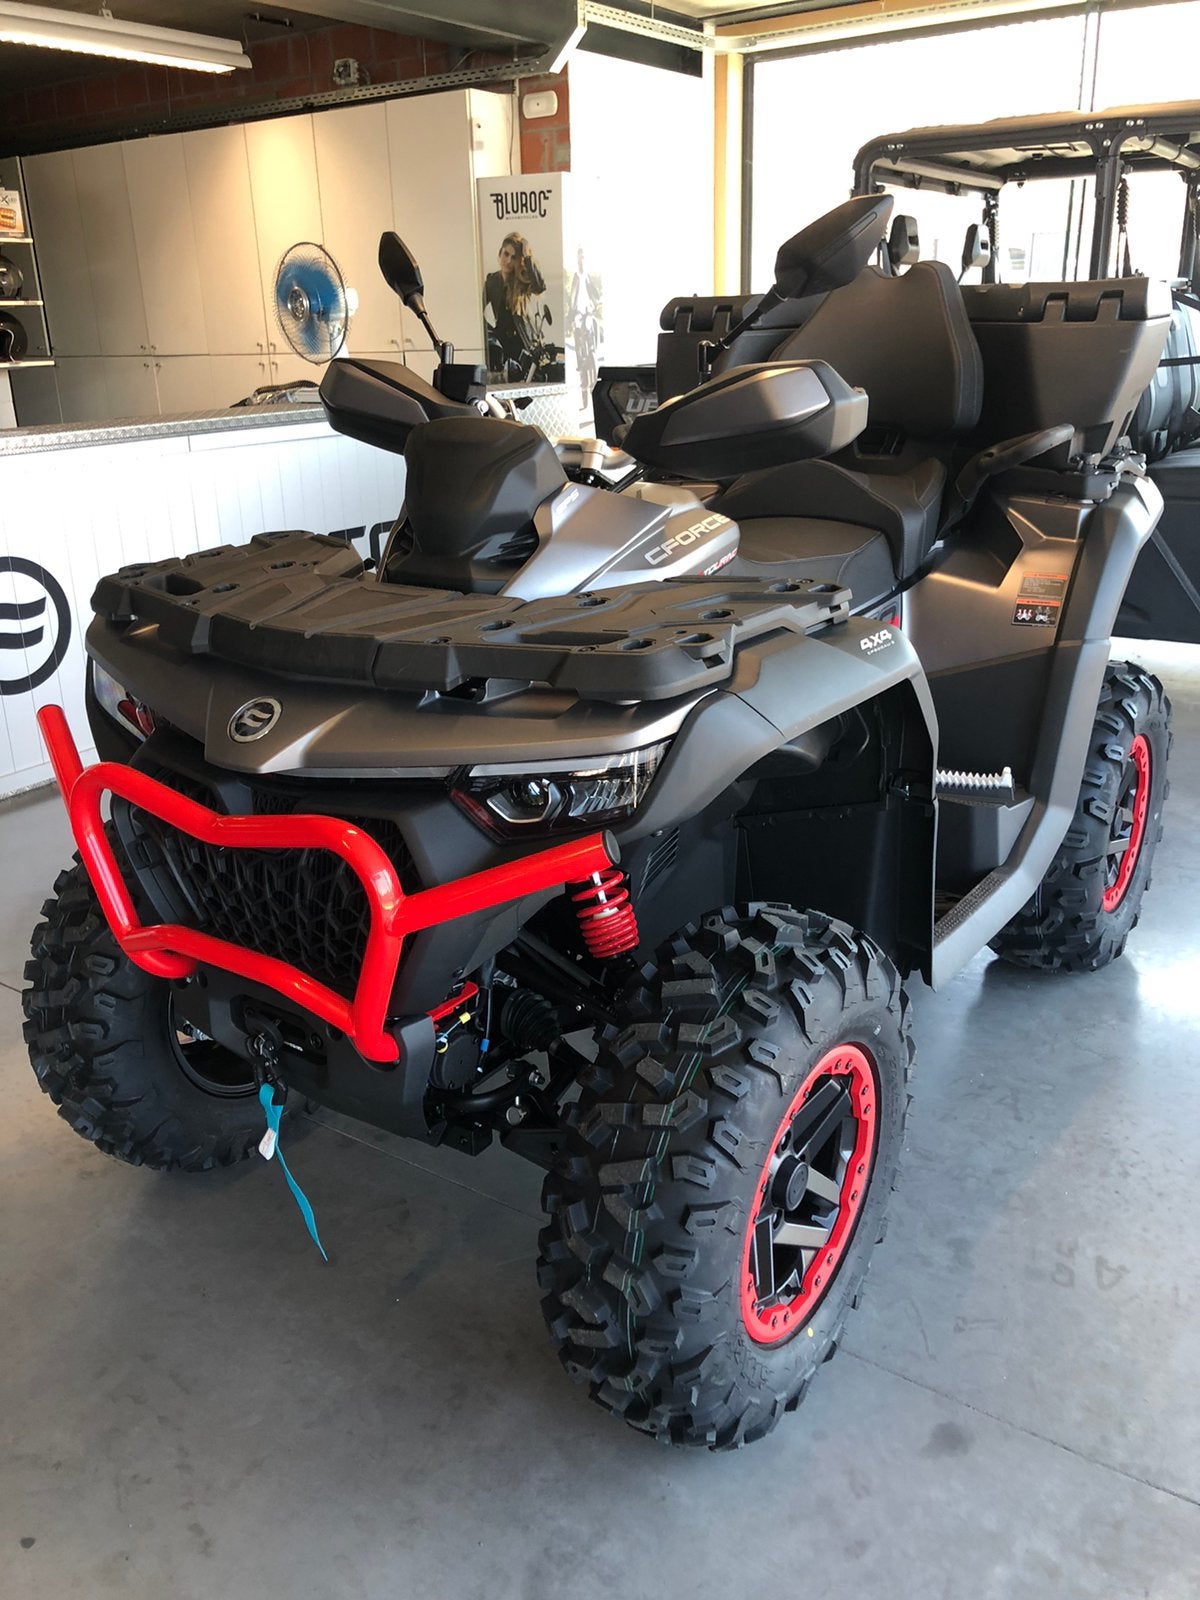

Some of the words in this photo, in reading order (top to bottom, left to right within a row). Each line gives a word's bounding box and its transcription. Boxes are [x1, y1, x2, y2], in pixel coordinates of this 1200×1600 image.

[489, 189, 553, 220] BLUROC
[644, 513, 731, 566] CFORCE
[860, 629, 893, 651] 4X4
